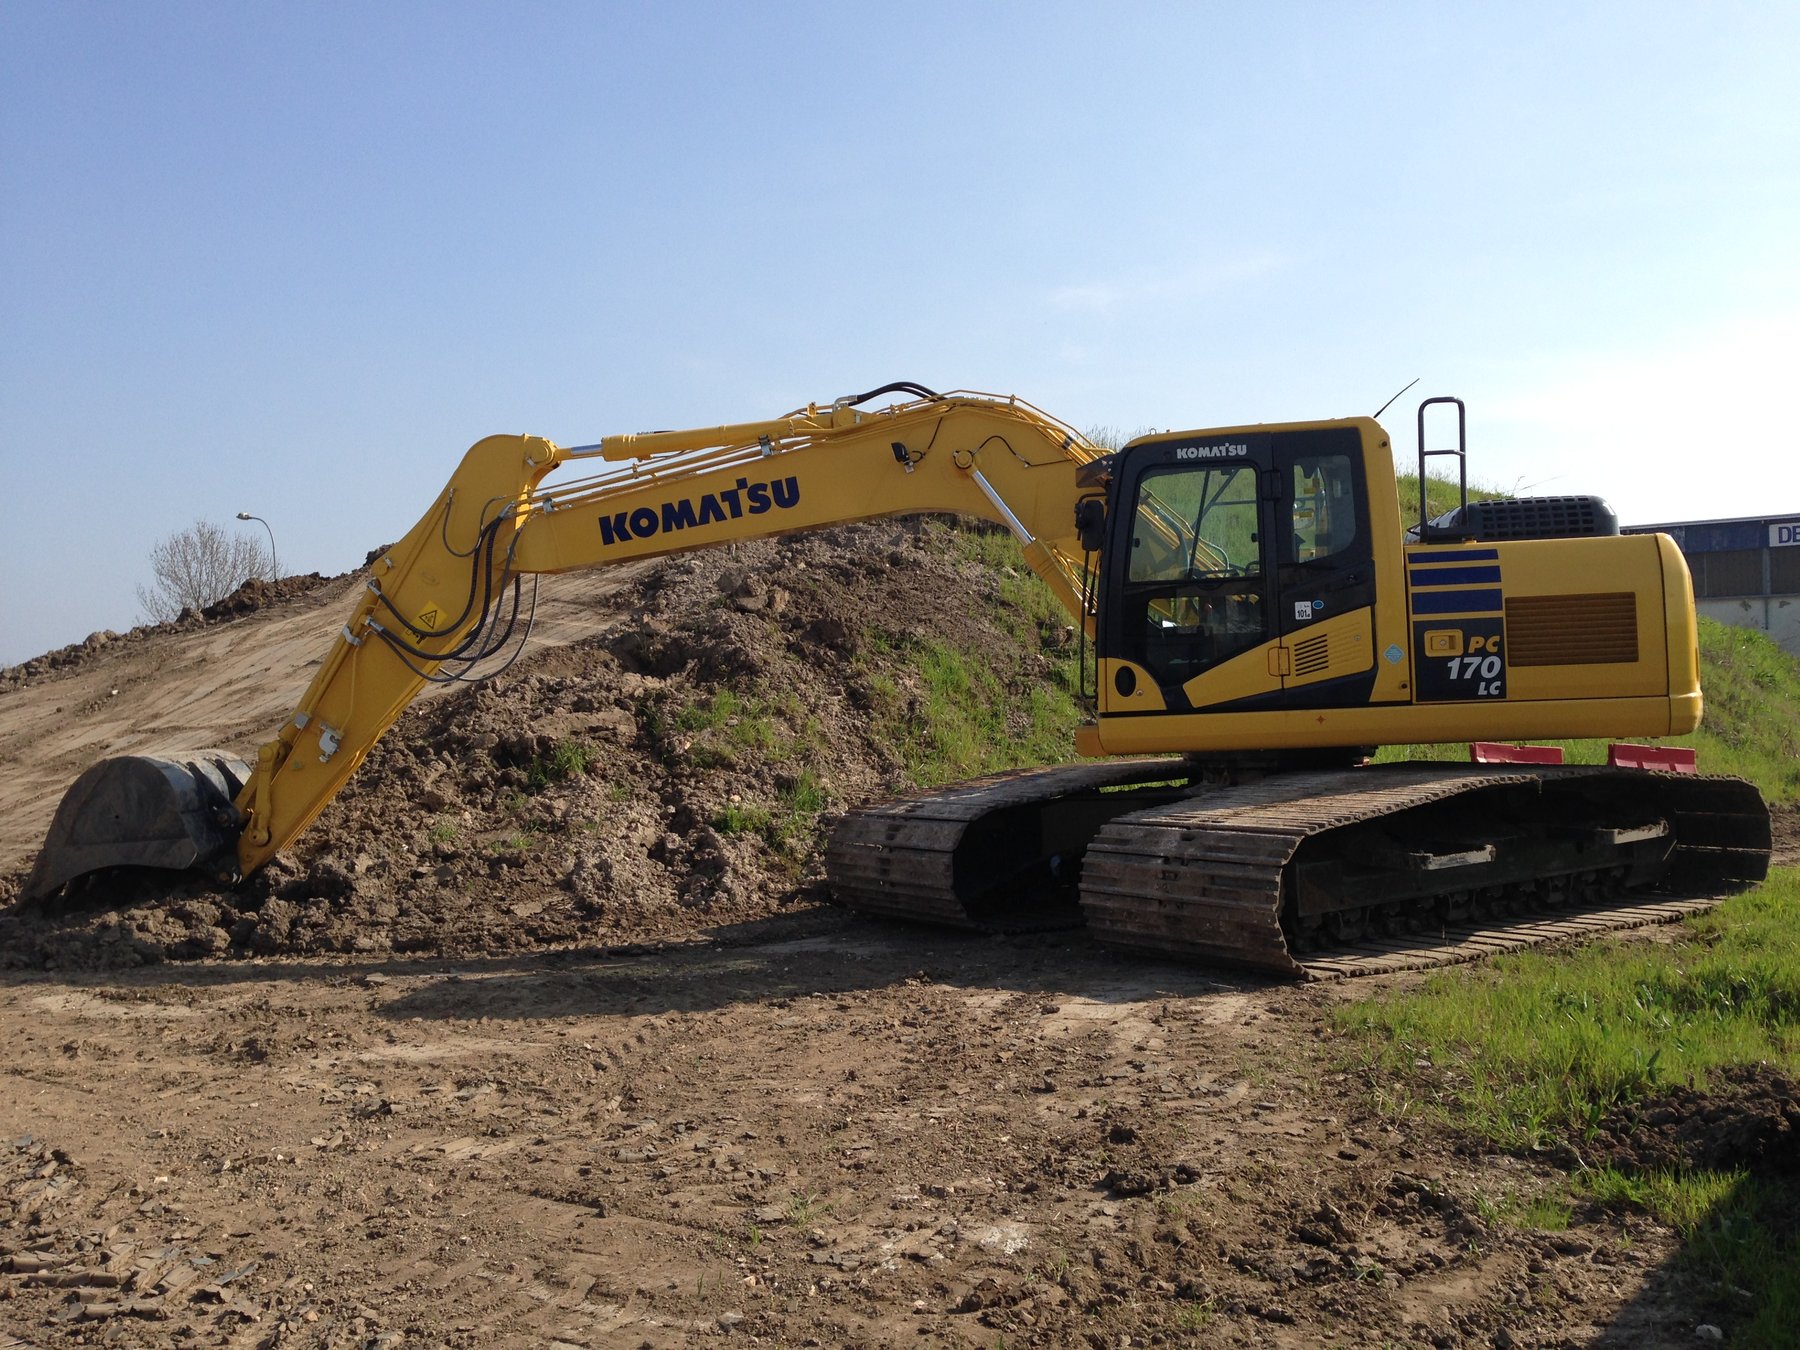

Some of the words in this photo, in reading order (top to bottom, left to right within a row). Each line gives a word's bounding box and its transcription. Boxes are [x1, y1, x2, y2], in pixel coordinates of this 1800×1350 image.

[1177, 443, 1247, 459] KOMATSU
[599, 476, 800, 546] KOMATSU
[1468, 636, 1500, 653] PC
[1447, 656, 1502, 679] 170
[1478, 681, 1501, 695] LC
